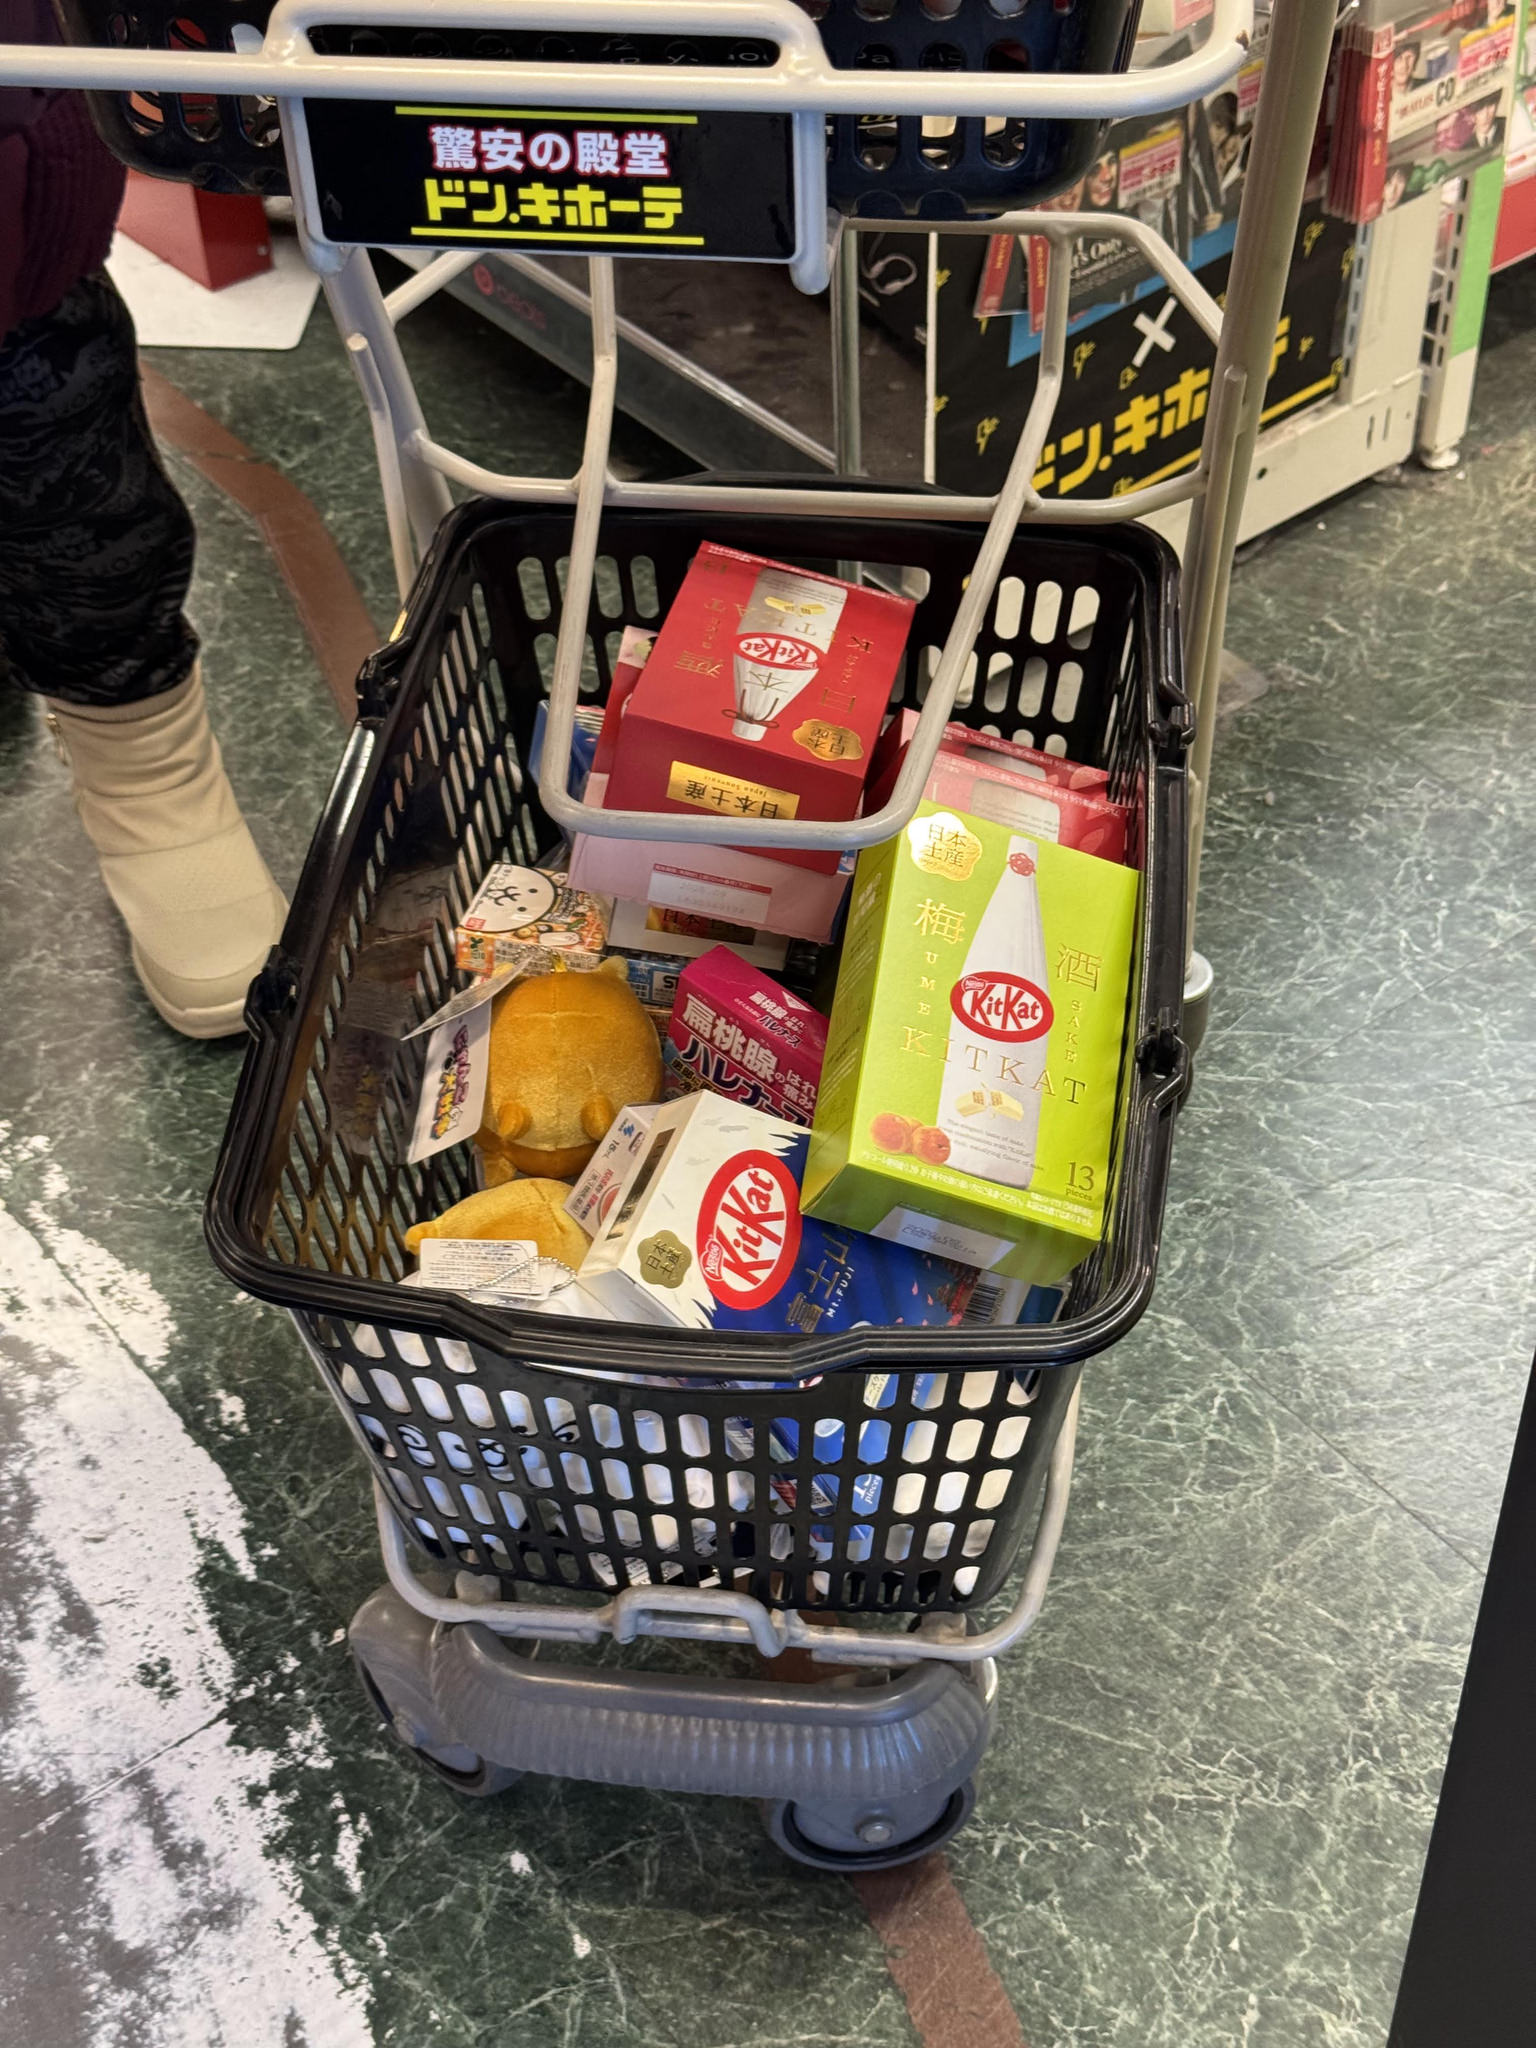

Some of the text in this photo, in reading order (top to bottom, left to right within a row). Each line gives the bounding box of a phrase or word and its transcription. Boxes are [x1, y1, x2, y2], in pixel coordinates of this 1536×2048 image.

[429, 124, 669, 177] 驚安の殿堂
[743, 636, 818, 663] KitKat
[744, 672, 792, 692] 本
[684, 778, 779, 819] 日本土産
[924, 842, 964, 868] 土産
[928, 824, 967, 848] 日本
[914, 898, 966, 944] 梅
[1055, 944, 1103, 992] 酒
[969, 983, 1040, 1030] KitKat
[1064, 1000, 1082, 1063] SAKE
[901, 1026, 1087, 1105] KITKAT
[1066, 1161, 1095, 1192] 13
[716, 1169, 785, 1286] KitKat
[647, 1238, 668, 1270] 日本
